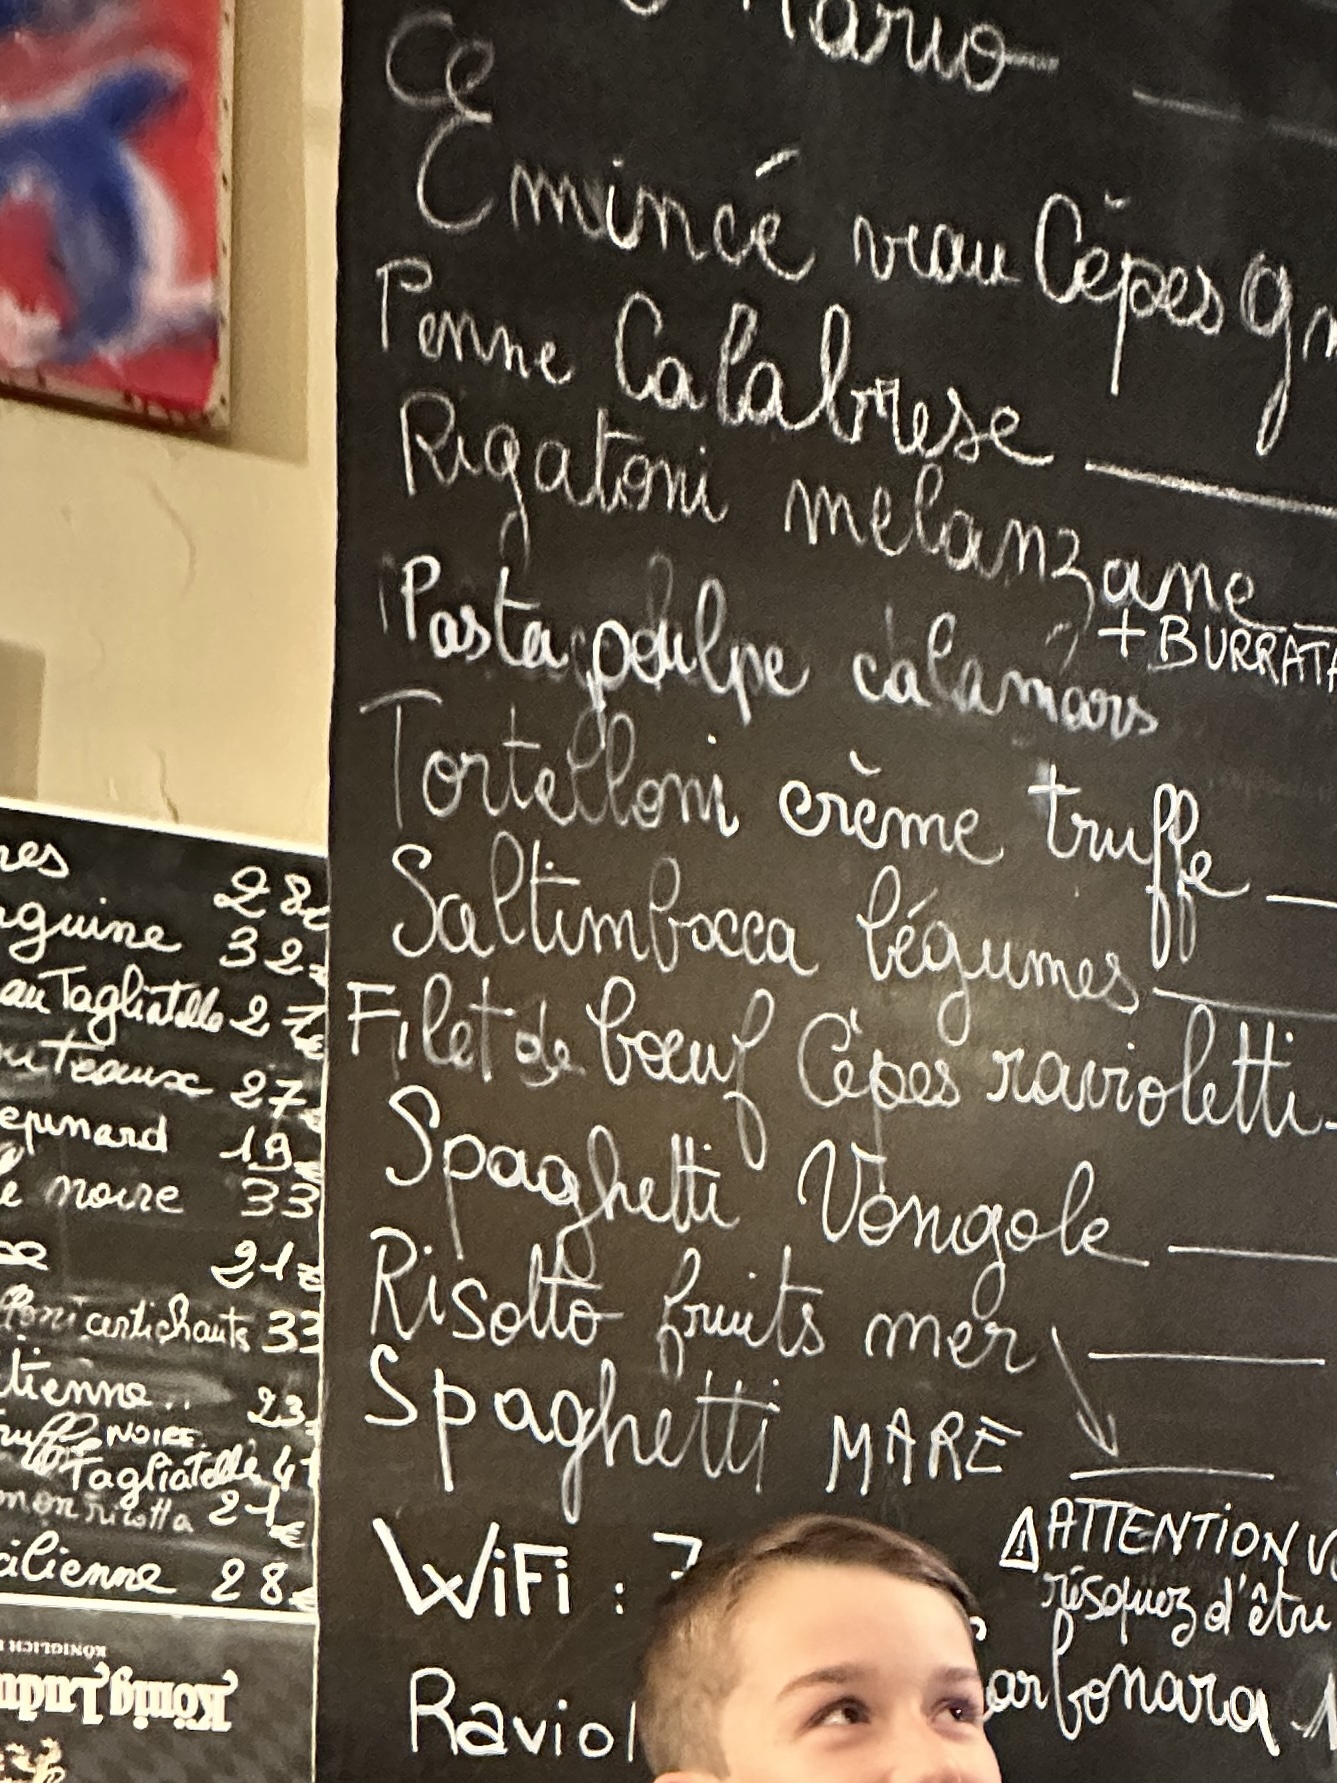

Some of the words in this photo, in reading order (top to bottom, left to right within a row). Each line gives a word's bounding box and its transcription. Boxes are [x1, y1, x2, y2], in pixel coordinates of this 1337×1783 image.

[740, 0, 1006, 91] ario
[376, 256, 574, 386] Penne
[615, 291, 1054, 465] Calabrese
[400, 390, 728, 574] Rigatoni
[784, 462, 1289, 674] melanzane
[400, 554, 569, 662] Pasta
[359, 688, 741, 838] Tortelloni
[779, 749, 1004, 866] crème
[1028, 764, 1250, 970] truffe
[391, 830, 819, 974] Saltimbocca
[856, 864, 1141, 1048] légumes
[347, 972, 516, 1082] Filet
[385, 1084, 741, 1281] Spaghetti
[797, 1138, 1152, 1322] Vongole
[657, 1247, 827, 1380] fruits
[864, 1310, 1038, 1374] mer
[365, 1342, 781, 1525] Spaghetti
[826, 1406, 1024, 1496] MARE
[373, 1517, 570, 1620] WiFi
[1047, 1496, 1300, 1568] ATTENTION
[109, 1665, 239, 1732] König
[410, 1666, 638, 1763] Raviol
[983, 1610, 1281, 1758] arbonara
